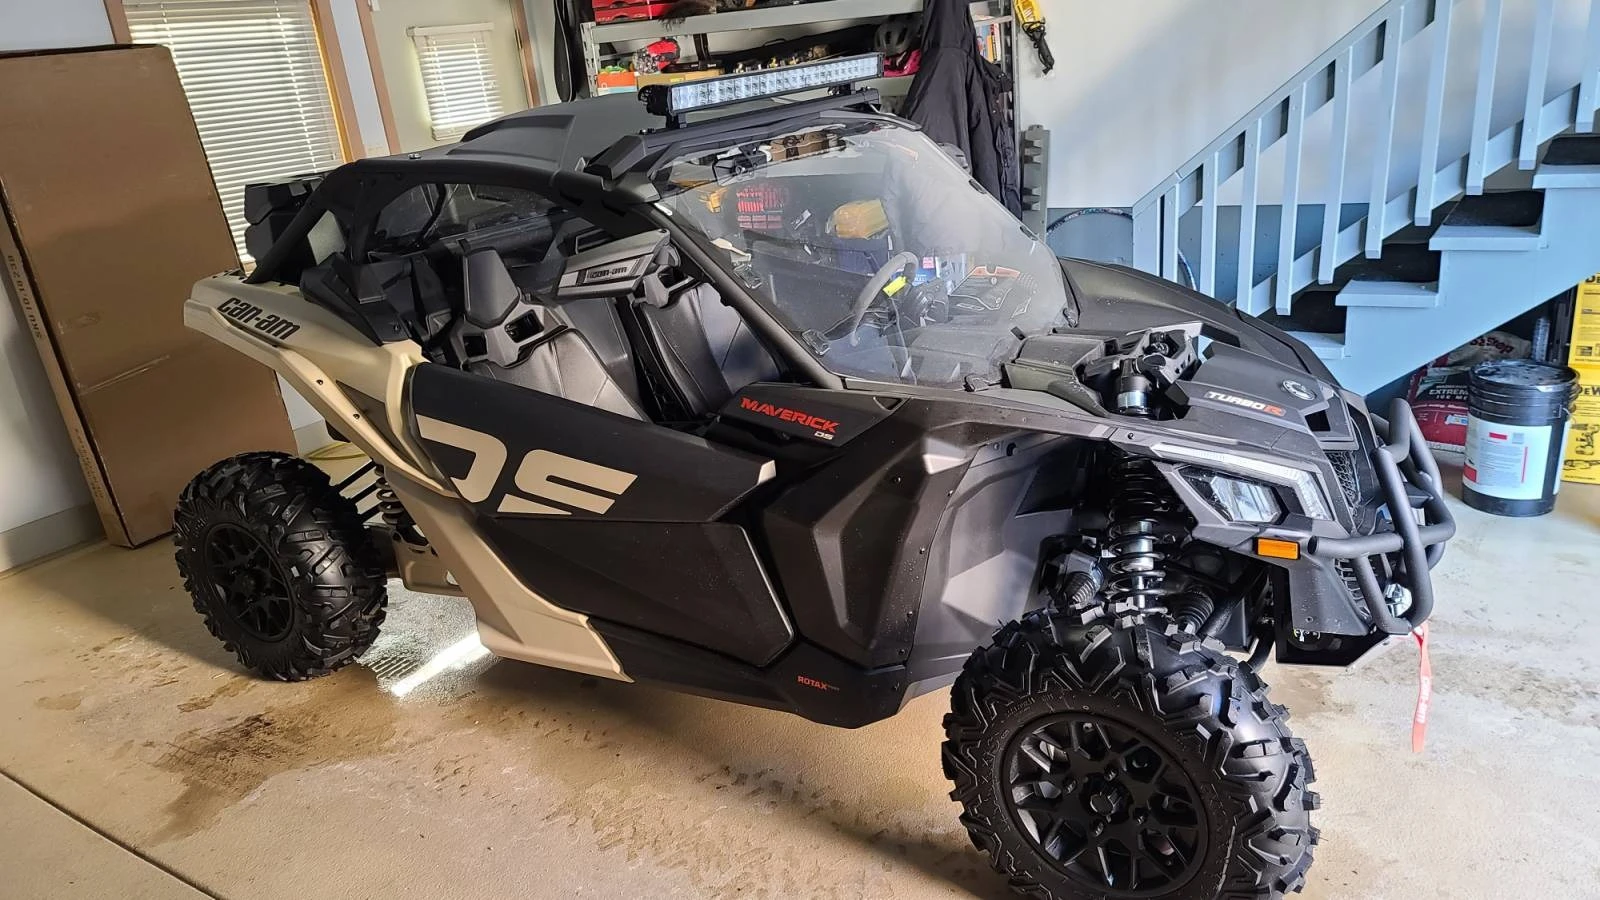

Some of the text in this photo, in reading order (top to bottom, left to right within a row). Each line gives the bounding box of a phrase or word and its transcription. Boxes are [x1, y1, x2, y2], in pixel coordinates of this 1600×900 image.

[217, 297, 301, 341] can-am
[740, 397, 840, 433] MAVERICK
[814, 430, 834, 440] DS
[797, 675, 828, 690] ROTAX
